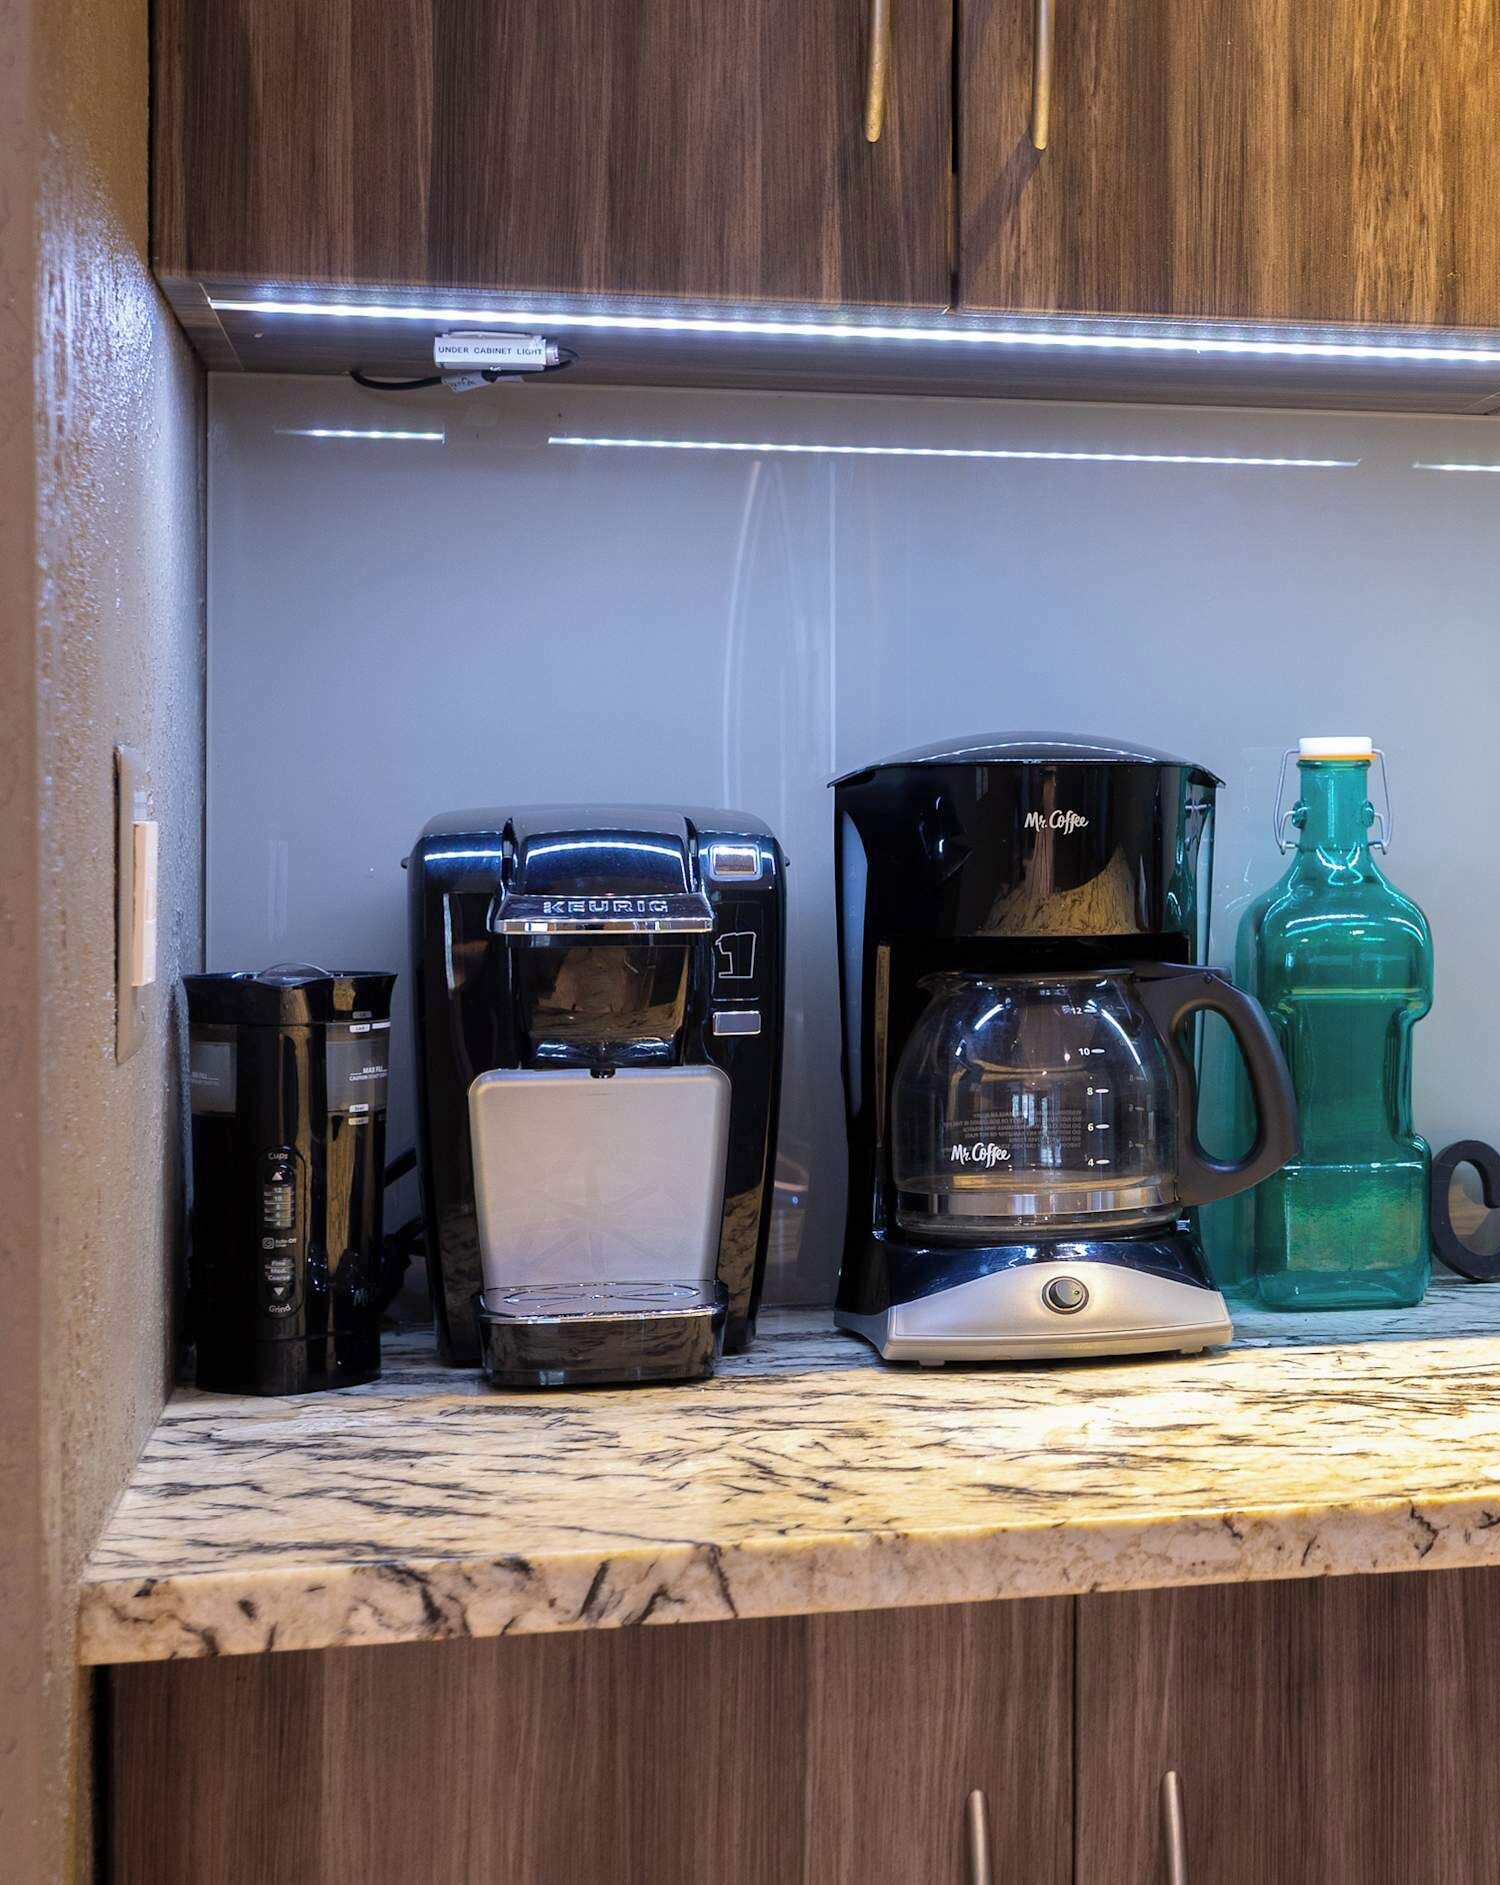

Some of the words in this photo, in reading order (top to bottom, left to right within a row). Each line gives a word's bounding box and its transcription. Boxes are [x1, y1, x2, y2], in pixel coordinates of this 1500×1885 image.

[438, 346, 469, 354] UNDER
[473, 347, 511, 355] CABINET
[516, 348, 542, 356] LIGHT
[1024, 811, 1048, 832] Mr.
[1049, 810, 1089, 835] Coffee
[543, 900, 668, 914] KEURIG
[1071, 1006, 1083, 1015] 12
[1078, 1047, 1091, 1056] 10
[1086, 1086, 1094, 1096] 8
[1087, 1122, 1094, 1132] 6
[268, 1152, 288, 1160] Cups
[951, 1144, 971, 1165] Mr.
[972, 1142, 1011, 1168] Coffee
[1087, 1158, 1095, 1167] 4
[268, 1303, 292, 1313] Grind
